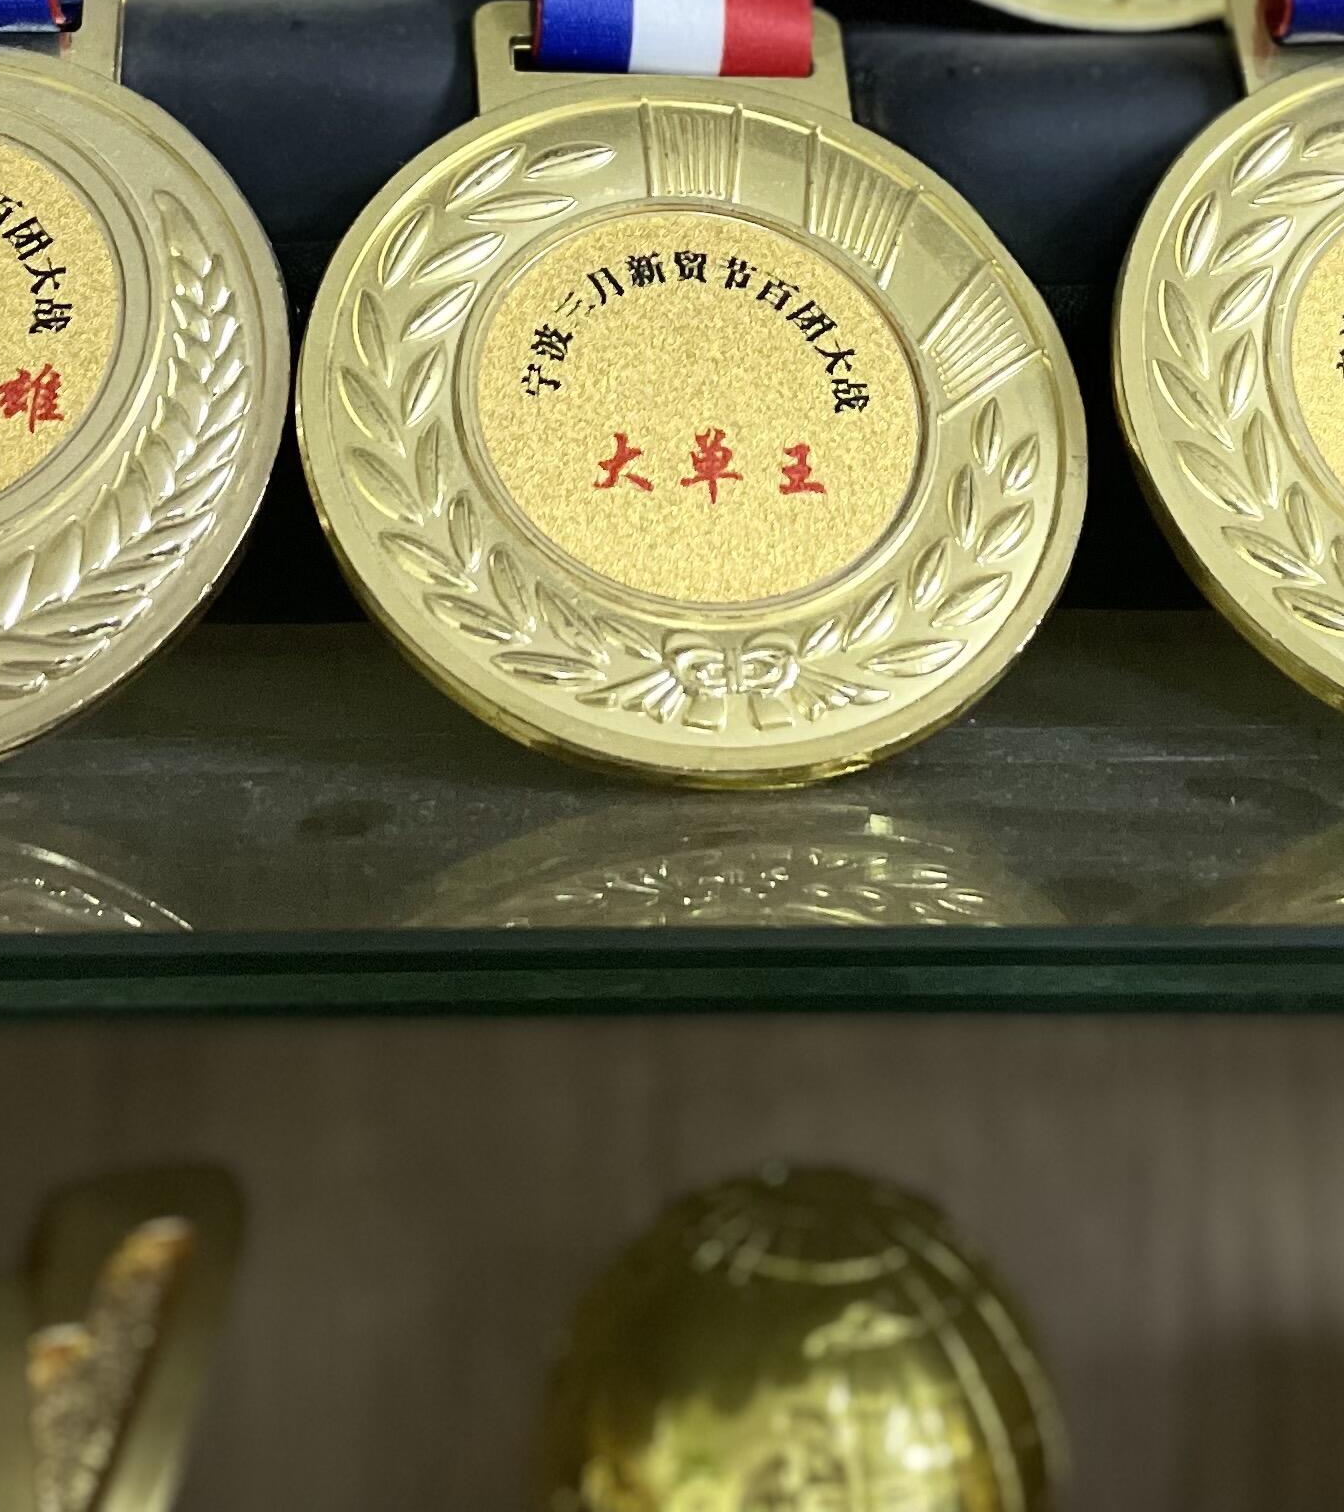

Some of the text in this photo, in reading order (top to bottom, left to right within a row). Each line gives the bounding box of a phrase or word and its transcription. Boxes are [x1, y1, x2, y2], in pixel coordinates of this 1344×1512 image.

[521, 251, 870, 413] 宁波三月新贸节百团大战
[593, 428, 827, 504] 大单王
